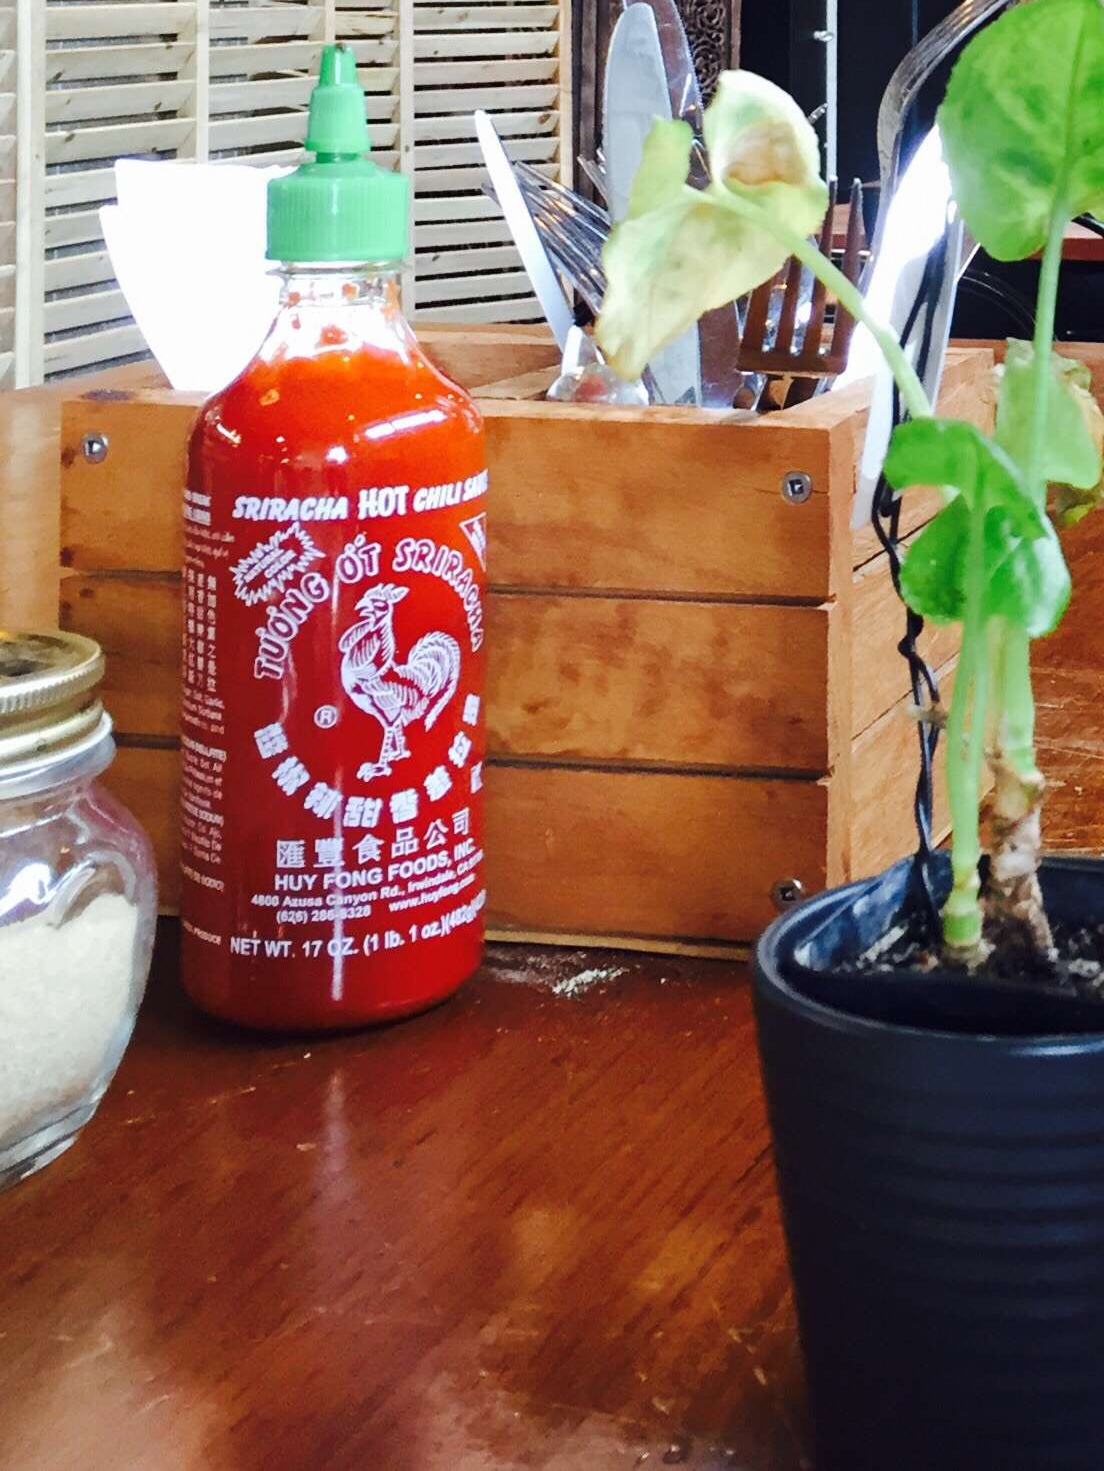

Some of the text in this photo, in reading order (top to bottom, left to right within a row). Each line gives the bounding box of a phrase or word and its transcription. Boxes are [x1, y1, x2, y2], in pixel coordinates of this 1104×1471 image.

[232, 495, 349, 522] SRIRACHA
[357, 484, 410, 520] HOT
[413, 481, 463, 513] CHILI
[392, 536, 484, 653] SRIRACHA
[274, 874, 318, 891] HUY
[323, 868, 383, 889] FONG
[388, 850, 452, 881] FOODS,
[326, 891, 378, 907] Canyon
[230, 936, 261, 956] NET
[264, 940, 296, 959] WT.
[302, 939, 323, 958] 17
[327, 936, 360, 958] OZ.
[363, 932, 379, 957] (1
[384, 929, 406, 950] lb.
[409, 924, 418, 943] 1
